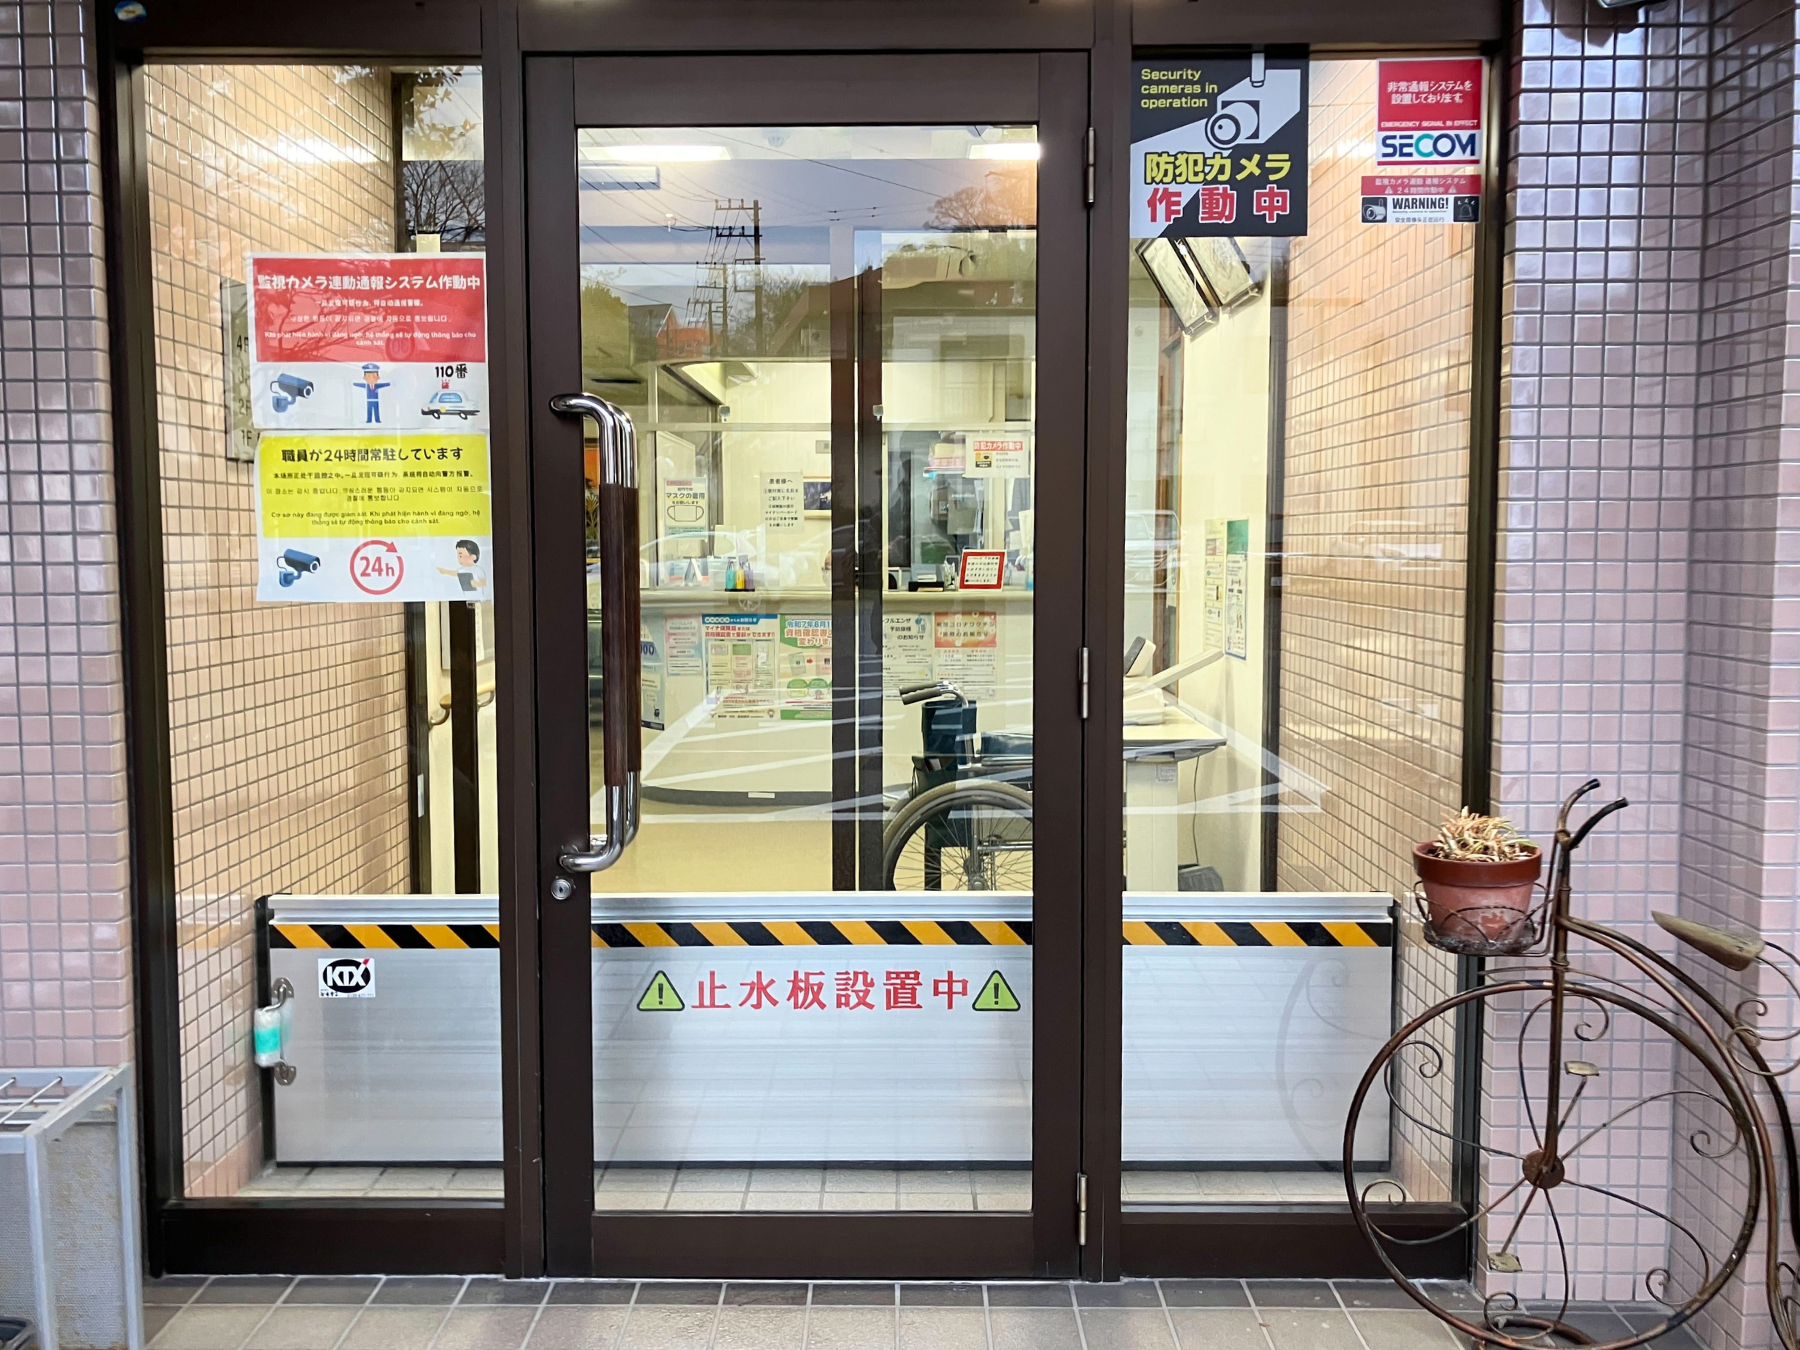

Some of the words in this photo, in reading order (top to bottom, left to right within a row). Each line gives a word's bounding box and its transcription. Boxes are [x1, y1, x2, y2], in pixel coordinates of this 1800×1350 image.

[1141, 69, 1201, 81] Security
[1141, 84, 1201, 94] cameras
[1205, 82, 1218, 93] in
[1387, 80, 1473, 92] 非常通報システムを
[1141, 97, 1208, 109] operation
[1391, 93, 1464, 104] 設置しております。
[1381, 133, 1477, 158] SECOM
[1145, 152, 1292, 183] 防犯カメラ
[1146, 184, 1291, 223] 作動中
[1392, 198, 1449, 209] WARNING!
[257, 275, 481, 290] 監視カメラ連動通報システム作動中
[435, 363, 468, 379] 110番
[241, 430, 252, 447] 1F
[974, 441, 1023, 451] 防犯カメラ作動中
[281, 447, 463, 463] 職員が24時間常駐しています
[360, 556, 395, 577] 24h
[326, 959, 370, 986] KTX
[691, 970, 968, 1011] 止水板設置中
